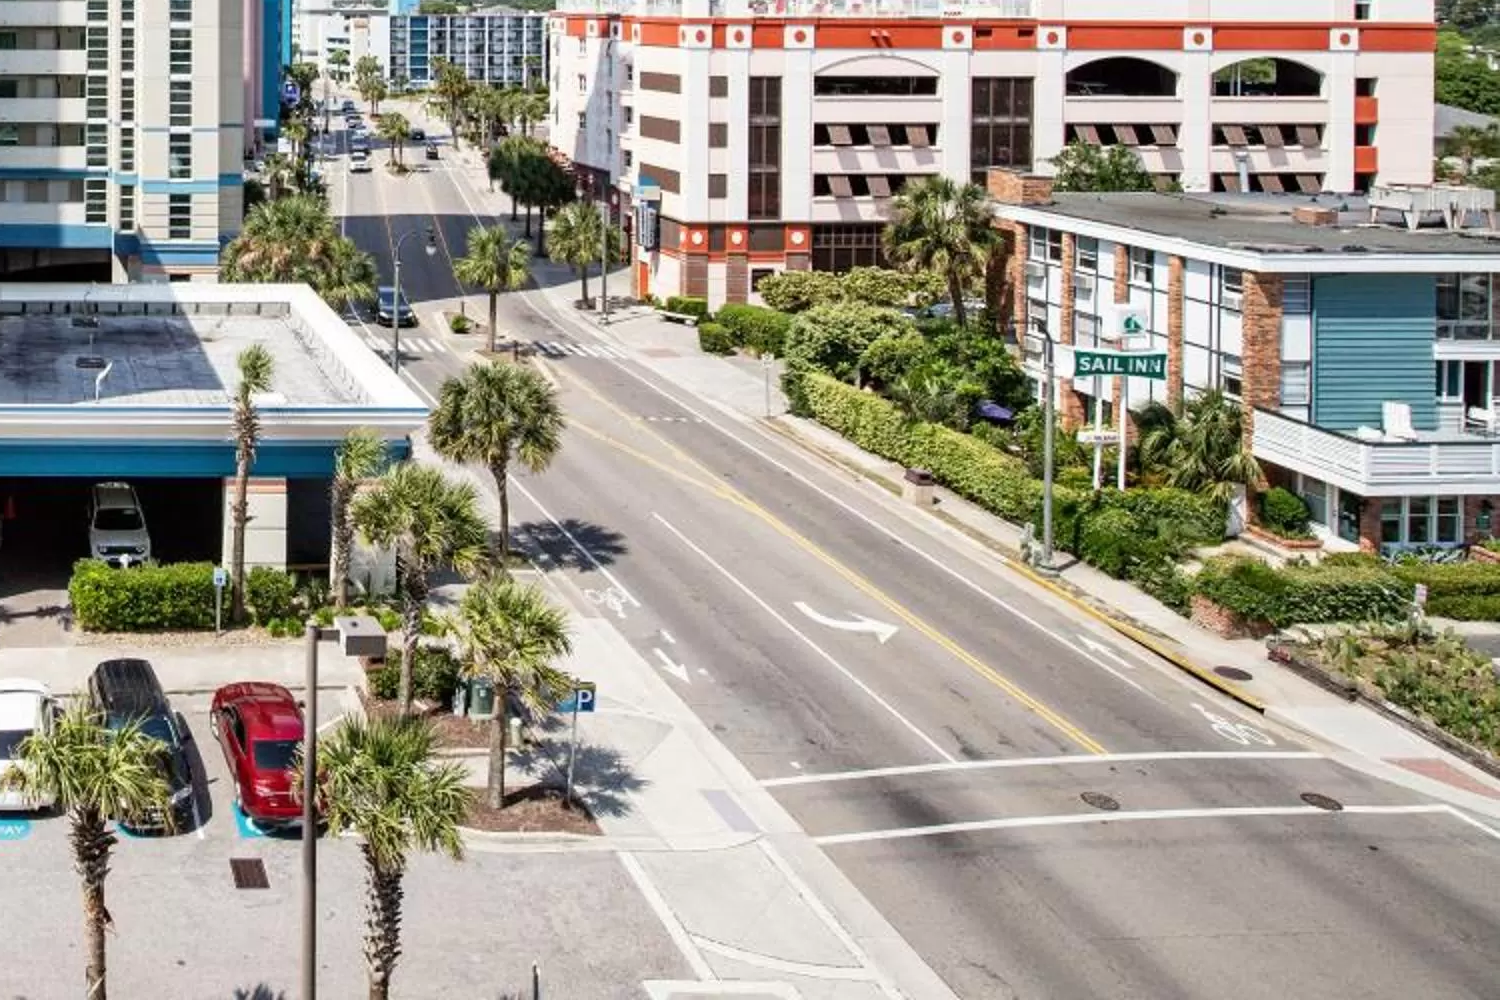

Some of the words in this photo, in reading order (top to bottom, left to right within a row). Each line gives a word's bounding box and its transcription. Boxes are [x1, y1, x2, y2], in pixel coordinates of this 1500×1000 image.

[1080, 357, 1124, 372] SAIL
[1128, 357, 1161, 373] INN
[577, 690, 592, 711] P
